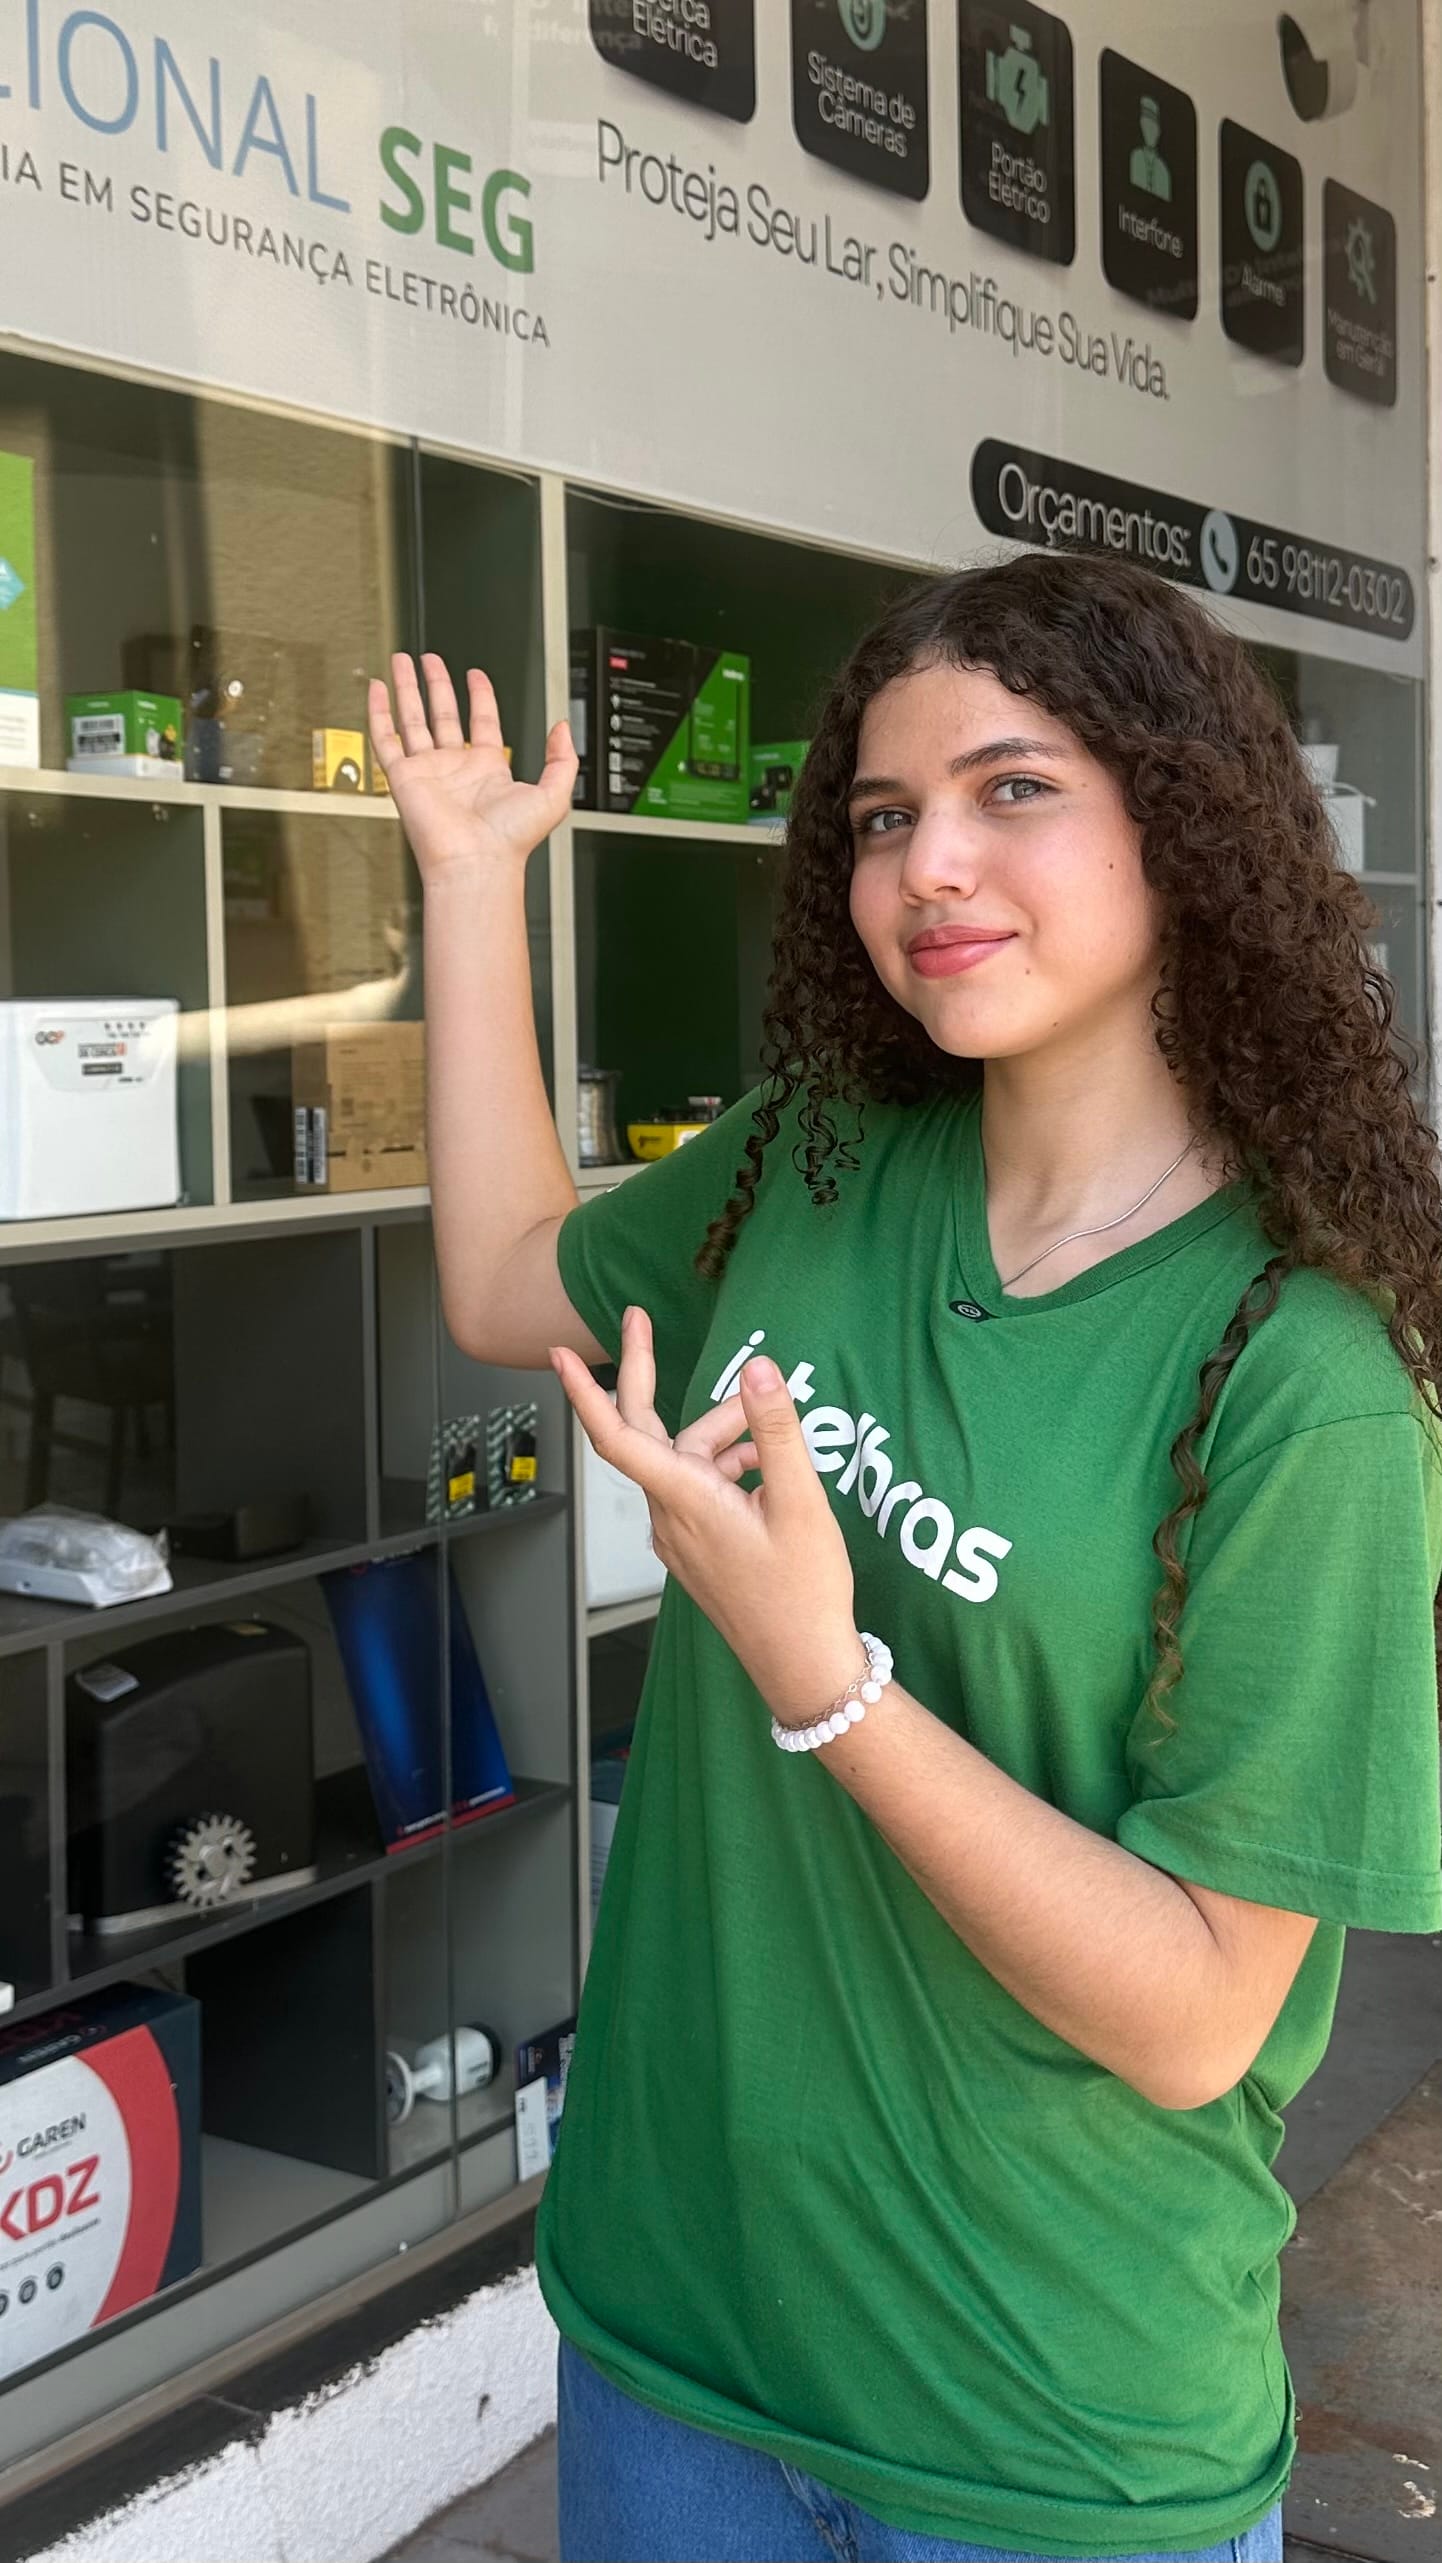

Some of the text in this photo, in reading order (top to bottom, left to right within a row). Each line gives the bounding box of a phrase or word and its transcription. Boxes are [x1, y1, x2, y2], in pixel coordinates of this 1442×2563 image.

[633, 0, 719, 69] Elétrica
[807, 51, 916, 130] Sistema de
[818, 90, 908, 158] Câmeras
[0, 0, 535, 274] IONAL SEG
[991, 141, 1048, 193] Portão
[989, 169, 1051, 224] Elétrico
[59, 163, 114, 212] EM
[130, 186, 353, 286] SEGURANÇA
[366, 261, 550, 348] ELETRÔNICA
[597, 118, 1170, 400] Proteja Seu Lar, Simplifique Sua Vida.
[1117, 204, 1184, 259] Interfone
[1241, 264, 1286, 307] Alarme
[998, 462, 1407, 626] Orçamentos: 65 98112-0302
[16, 2111, 87, 2158] GAREN
